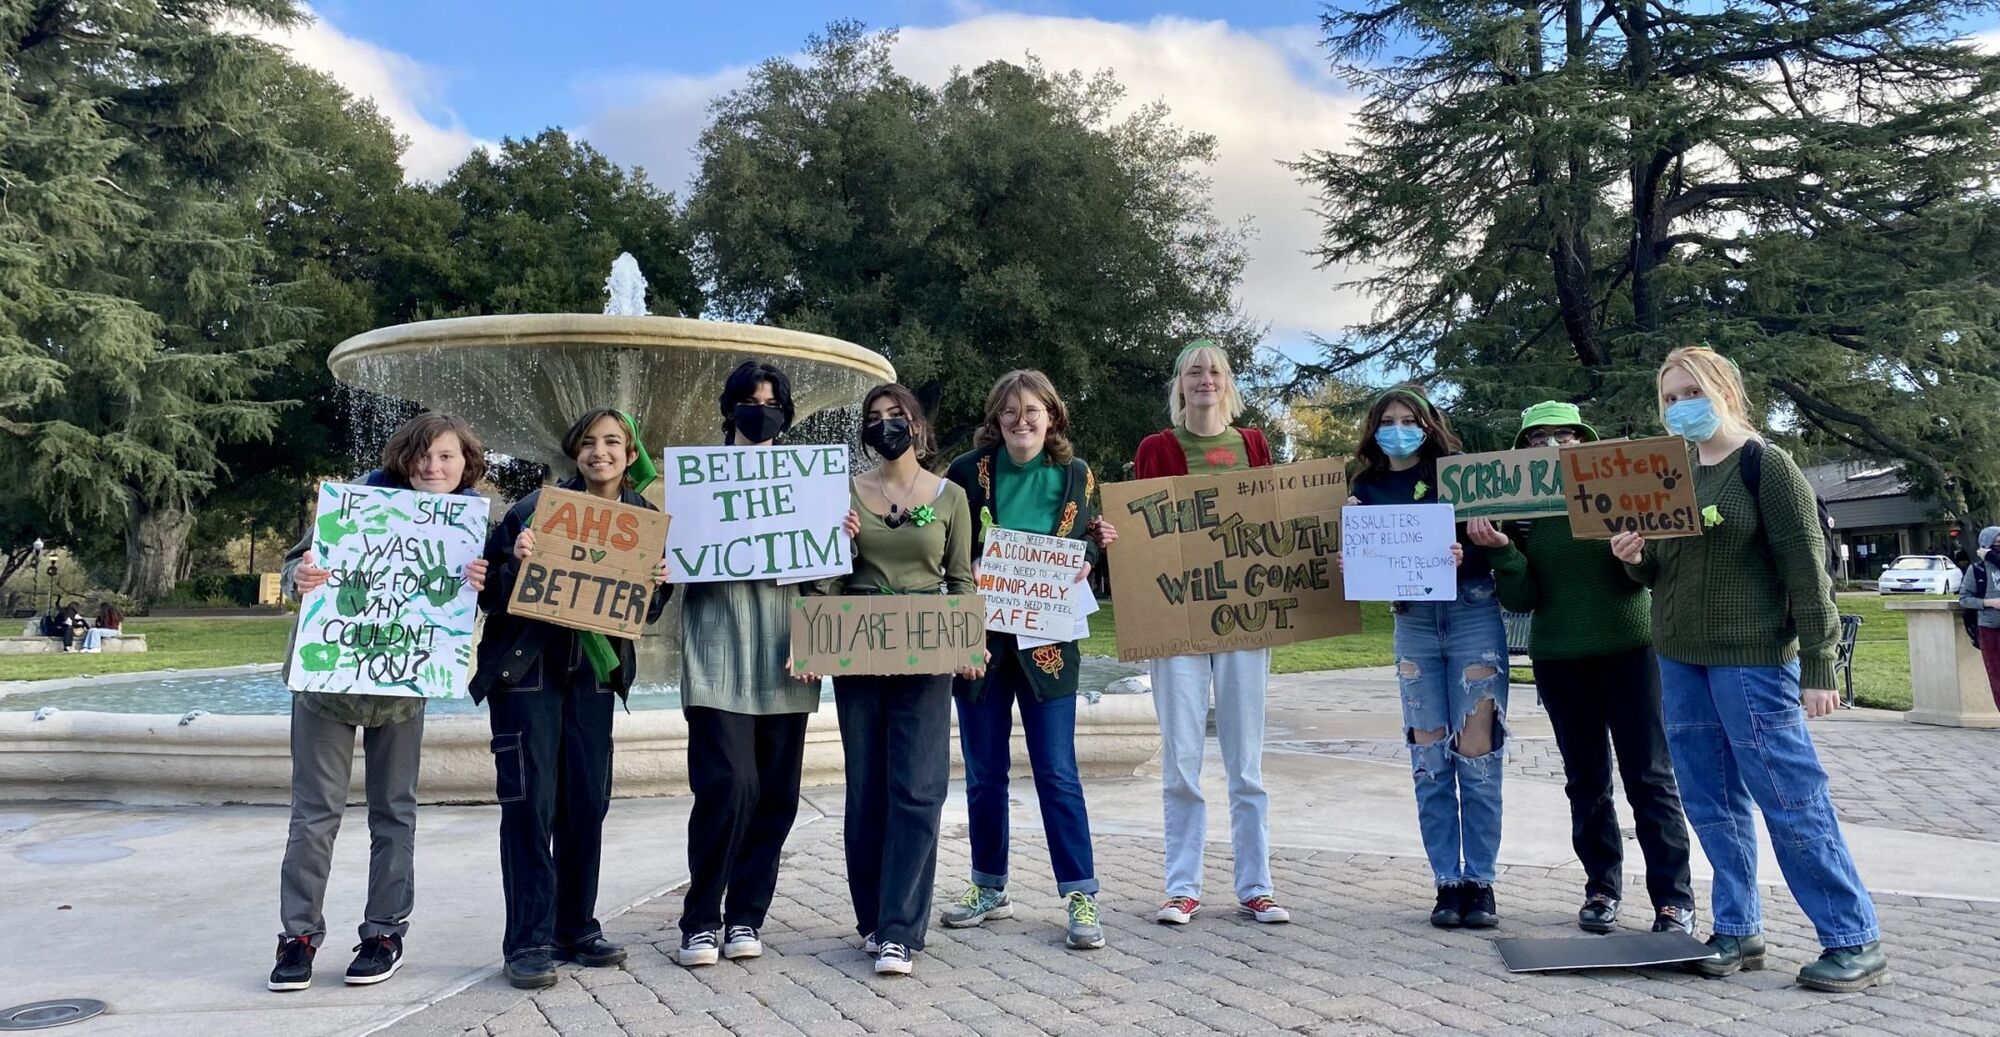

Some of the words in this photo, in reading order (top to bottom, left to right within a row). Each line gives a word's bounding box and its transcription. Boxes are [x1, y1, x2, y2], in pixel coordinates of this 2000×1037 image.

[676, 447, 846, 486] BELIEVE
[1570, 447, 1669, 482] Listen
[1237, 479, 1275, 496] #AHS
[1280, 476, 1297, 490] DO
[1302, 471, 1346, 488] BETTER
[1439, 459, 1522, 506] SCREW
[340, 491, 369, 520] IF
[413, 500, 469, 526] SHE
[712, 484, 796, 522] THE
[1126, 487, 1221, 539] THE
[1573, 484, 1612, 514] to
[1619, 490, 1671, 512] our
[541, 502, 640, 552] AHS
[1344, 513, 1420, 530] ASSAULTERS
[1602, 506, 1695, 533] voices!
[363, 534, 419, 562] WAS
[990, 529, 1018, 542] PEOPLE
[1026, 535, 1044, 545] NEED
[1046, 537, 1053, 545] TO
[1208, 512, 1340, 559] TRUTH
[1381, 531, 1423, 545] BELONG
[672, 526, 844, 578] VICTIM
[1345, 547, 1357, 558] AT
[1387, 556, 1413, 569] THEY
[1415, 556, 1455, 569] BELONG
[325, 568, 386, 592] SKING
[393, 572, 432, 596] FOR
[438, 576, 461, 596] IT
[983, 561, 1008, 573] PEOPLE
[1013, 566, 1036, 577] NEED
[1039, 569, 1047, 577] TO
[1244, 557, 1331, 597] COME
[1406, 570, 1424, 582] IN
[516, 562, 648, 625] BETTER
[979, 574, 1069, 601] HONORABLY.
[351, 593, 411, 619] WHY
[986, 594, 1020, 607] TUDENTS
[1024, 600, 1042, 610] NEED
[1044, 602, 1051, 611] TO
[1053, 603, 1073, 614] FEEL
[1210, 598, 1299, 637] OUT.
[802, 603, 842, 656] YOU
[849, 612, 898, 651] ARE
[906, 611, 983, 650] HEARD
[986, 608, 1044, 631] AFE.
[353, 650, 431, 683] YOU?
